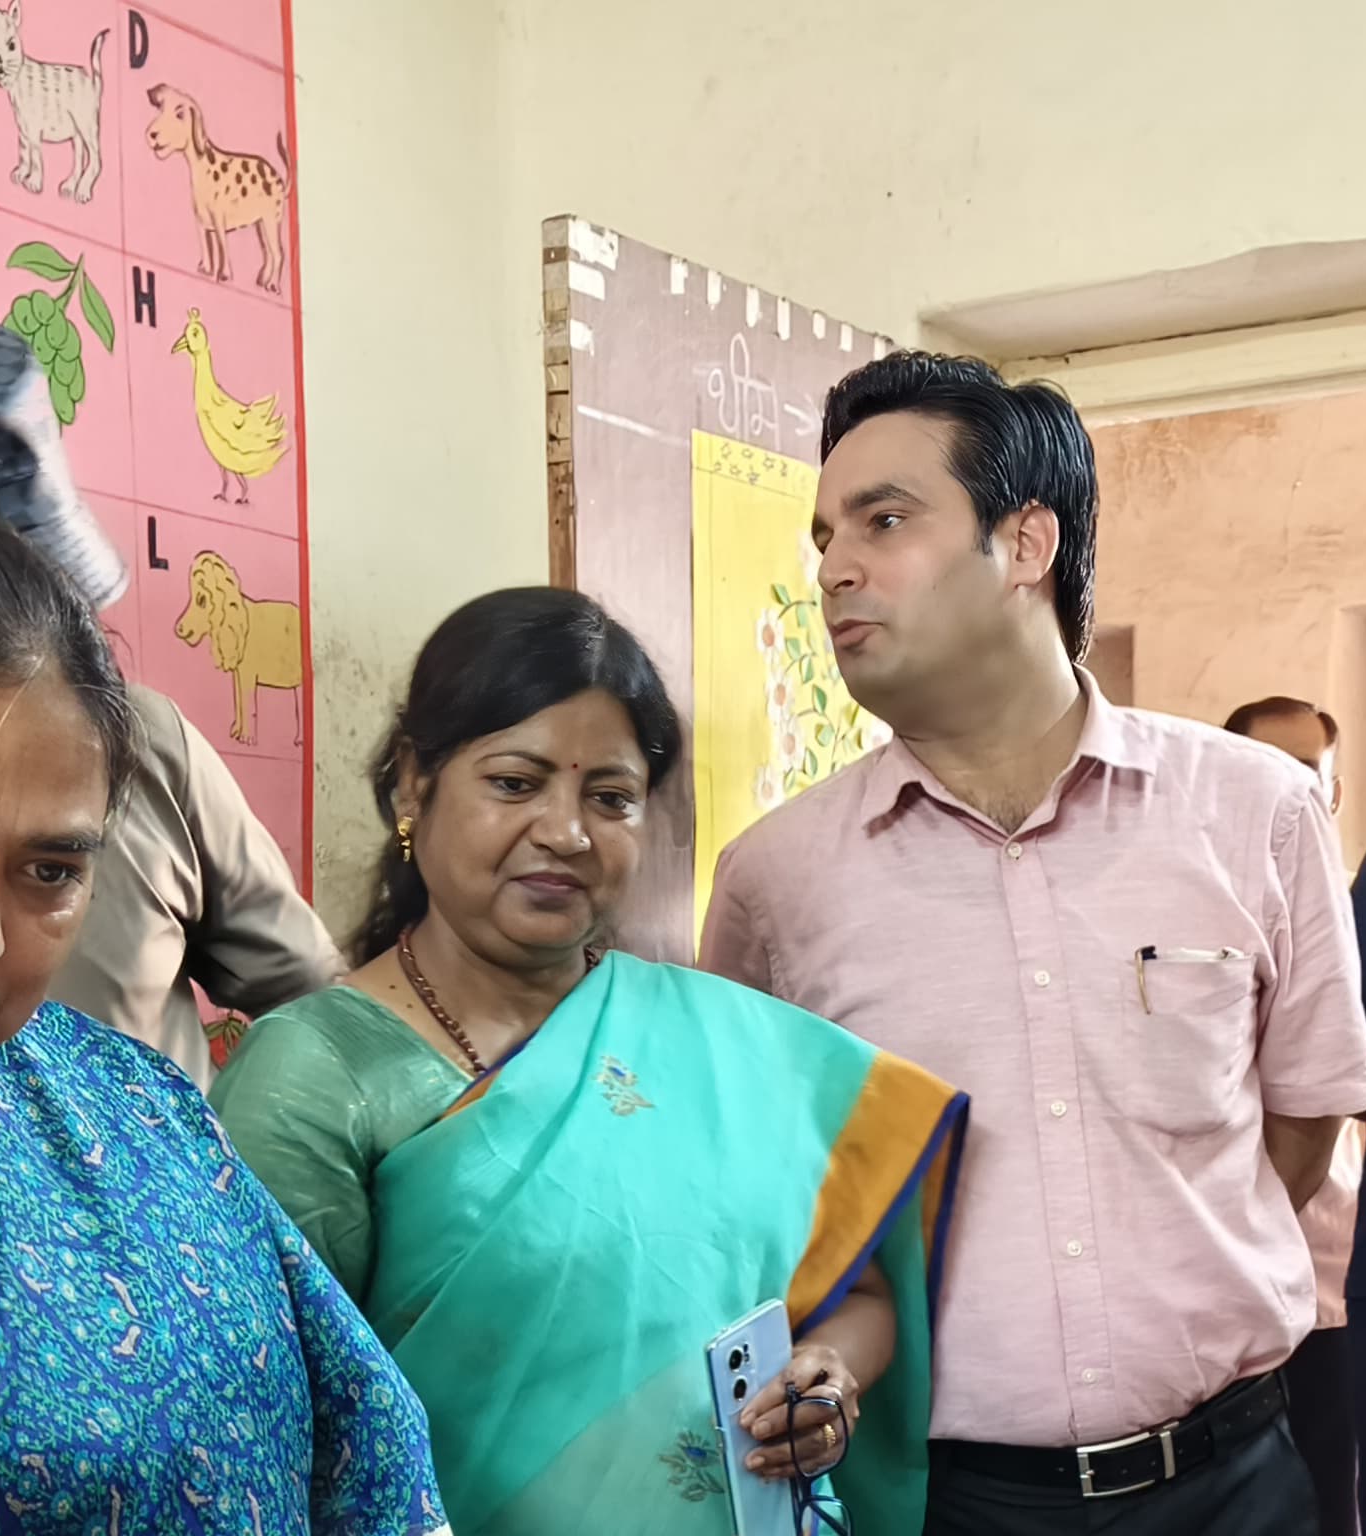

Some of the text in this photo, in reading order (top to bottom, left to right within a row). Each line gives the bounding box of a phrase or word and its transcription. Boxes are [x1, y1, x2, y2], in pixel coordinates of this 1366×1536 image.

[129, 9, 149, 69] D
[132, 266, 157, 328] H
[147, 516, 168, 570] L
